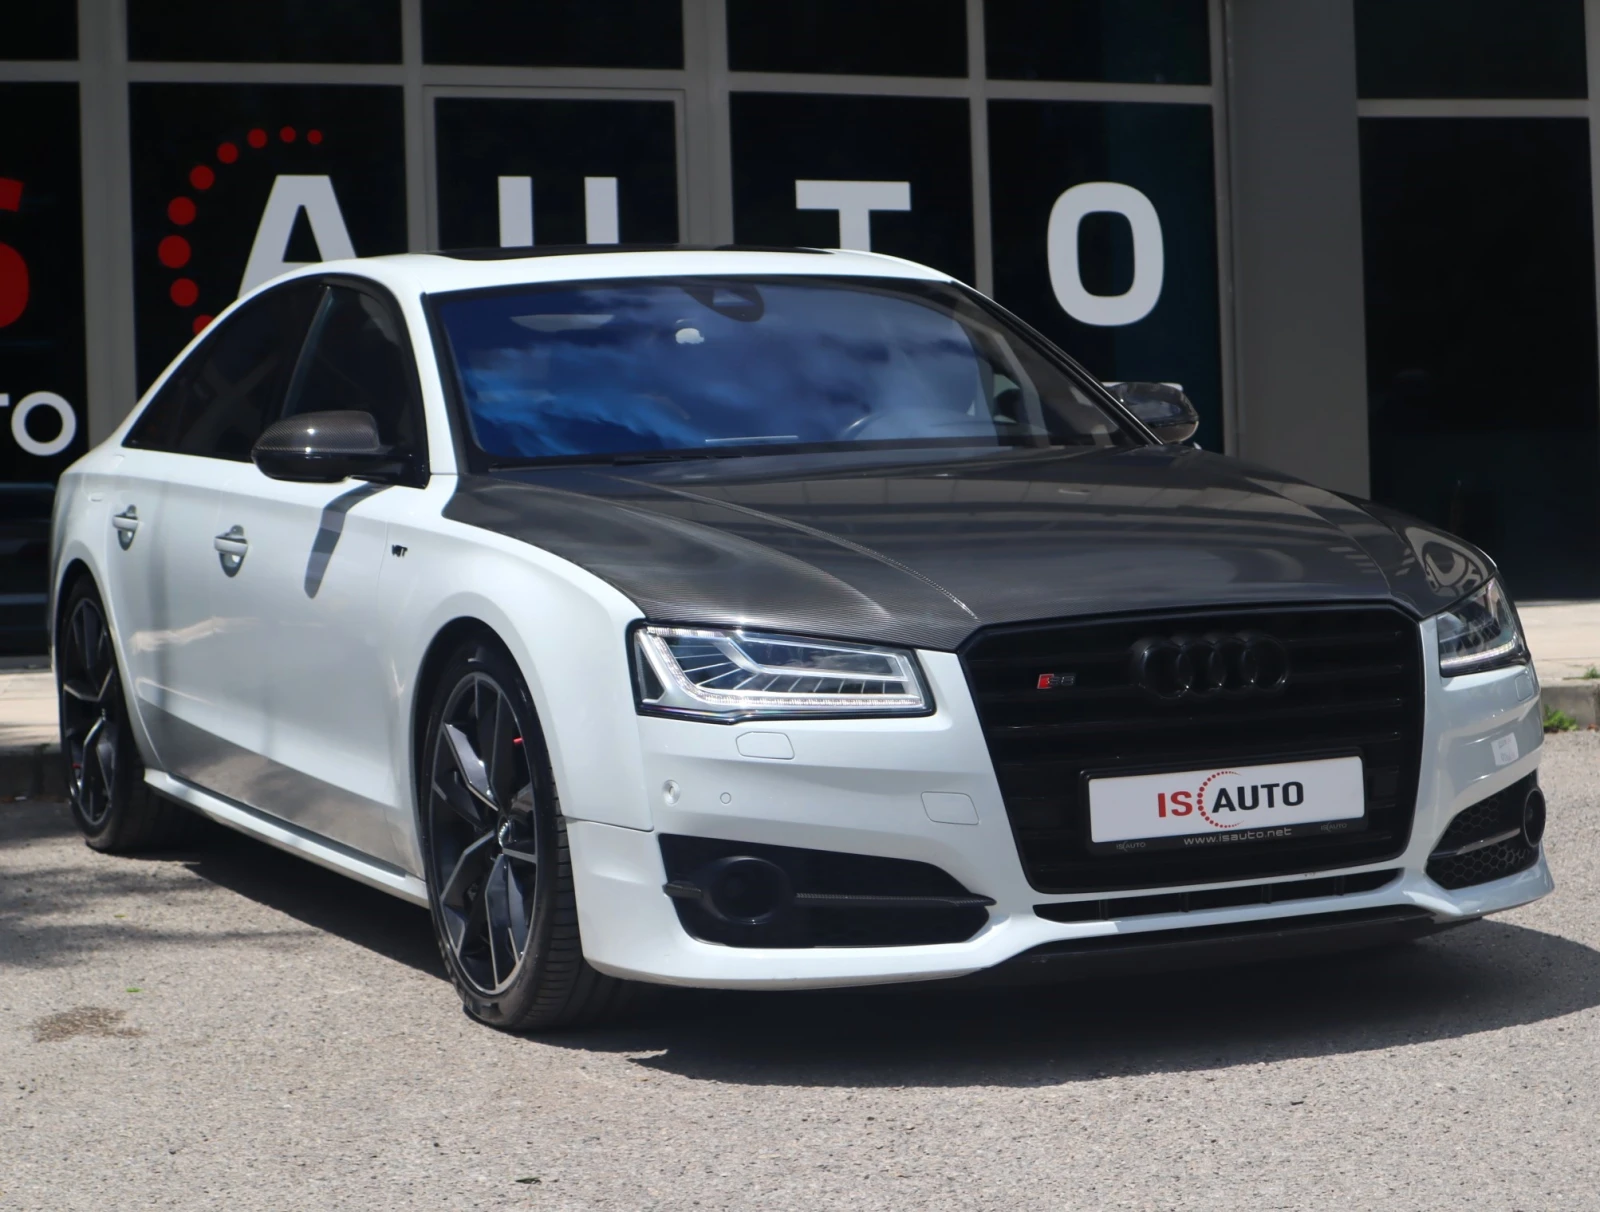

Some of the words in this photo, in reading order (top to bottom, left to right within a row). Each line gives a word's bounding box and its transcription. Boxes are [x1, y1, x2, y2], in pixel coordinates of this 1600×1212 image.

[0, 391, 76, 456] O
[1157, 791, 1193, 818] IS
[1211, 781, 1304, 814] AUTO
[1183, 827, 1292, 846] www.isauto.net
